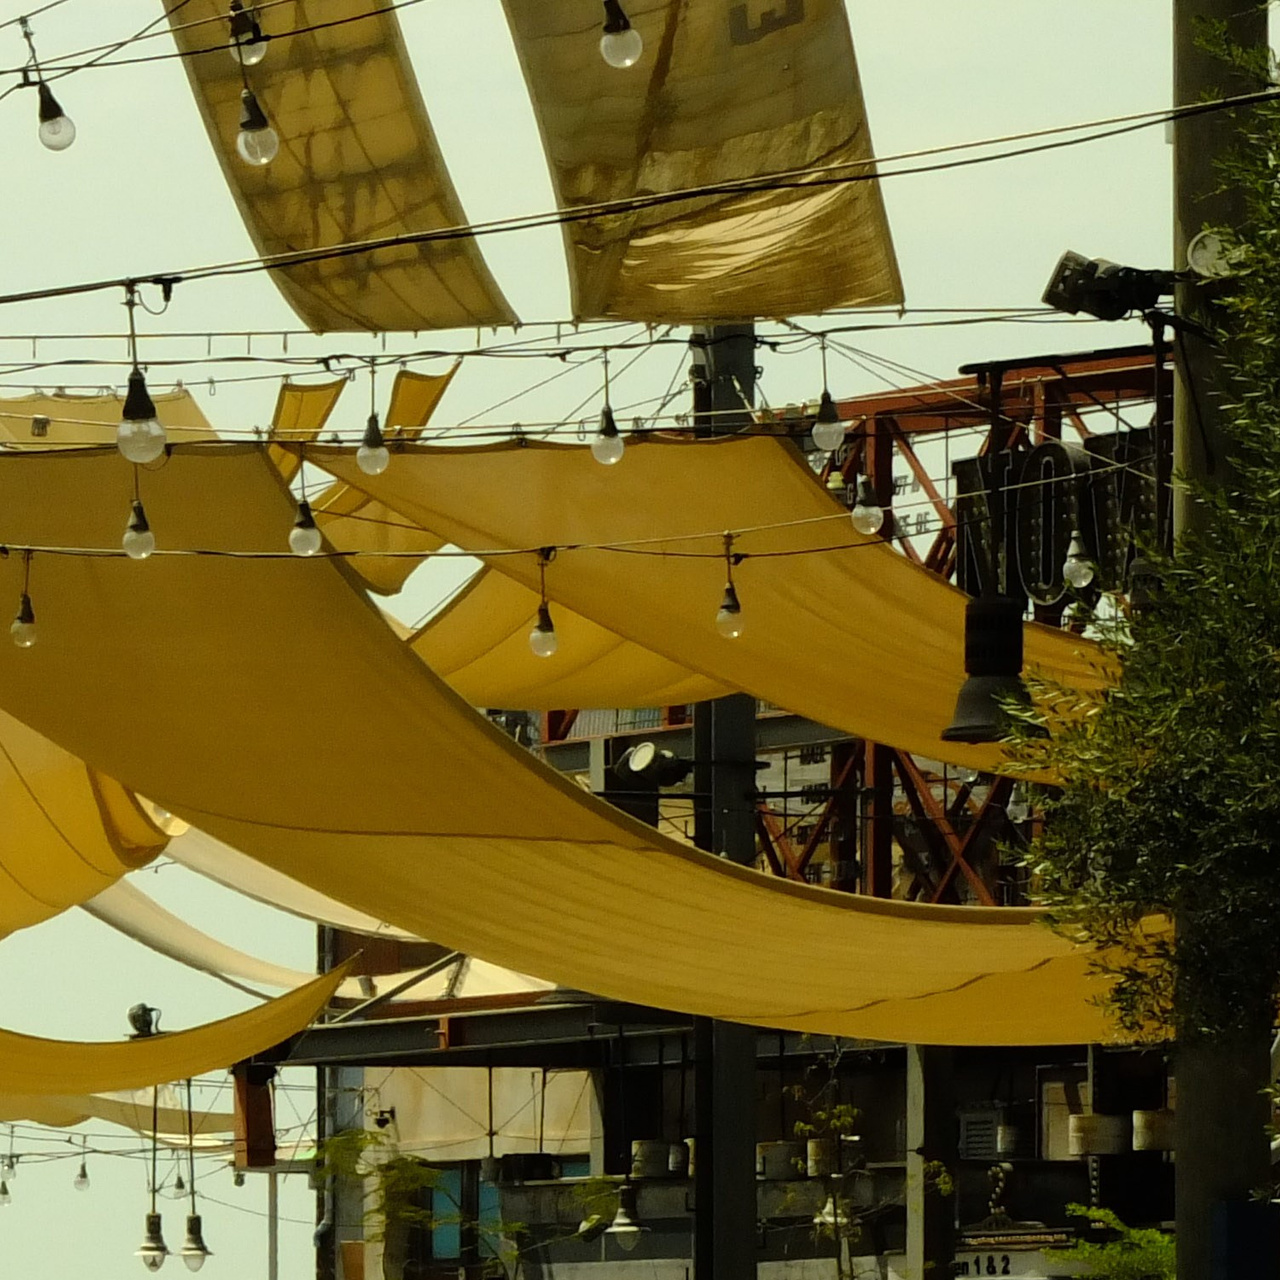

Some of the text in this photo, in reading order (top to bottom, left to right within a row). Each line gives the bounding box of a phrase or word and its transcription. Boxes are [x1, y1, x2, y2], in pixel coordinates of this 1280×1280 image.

[973, 1254, 980, 1275] 1
[986, 1254, 997, 1275] &
[1001, 1254, 1010, 1275] 2
